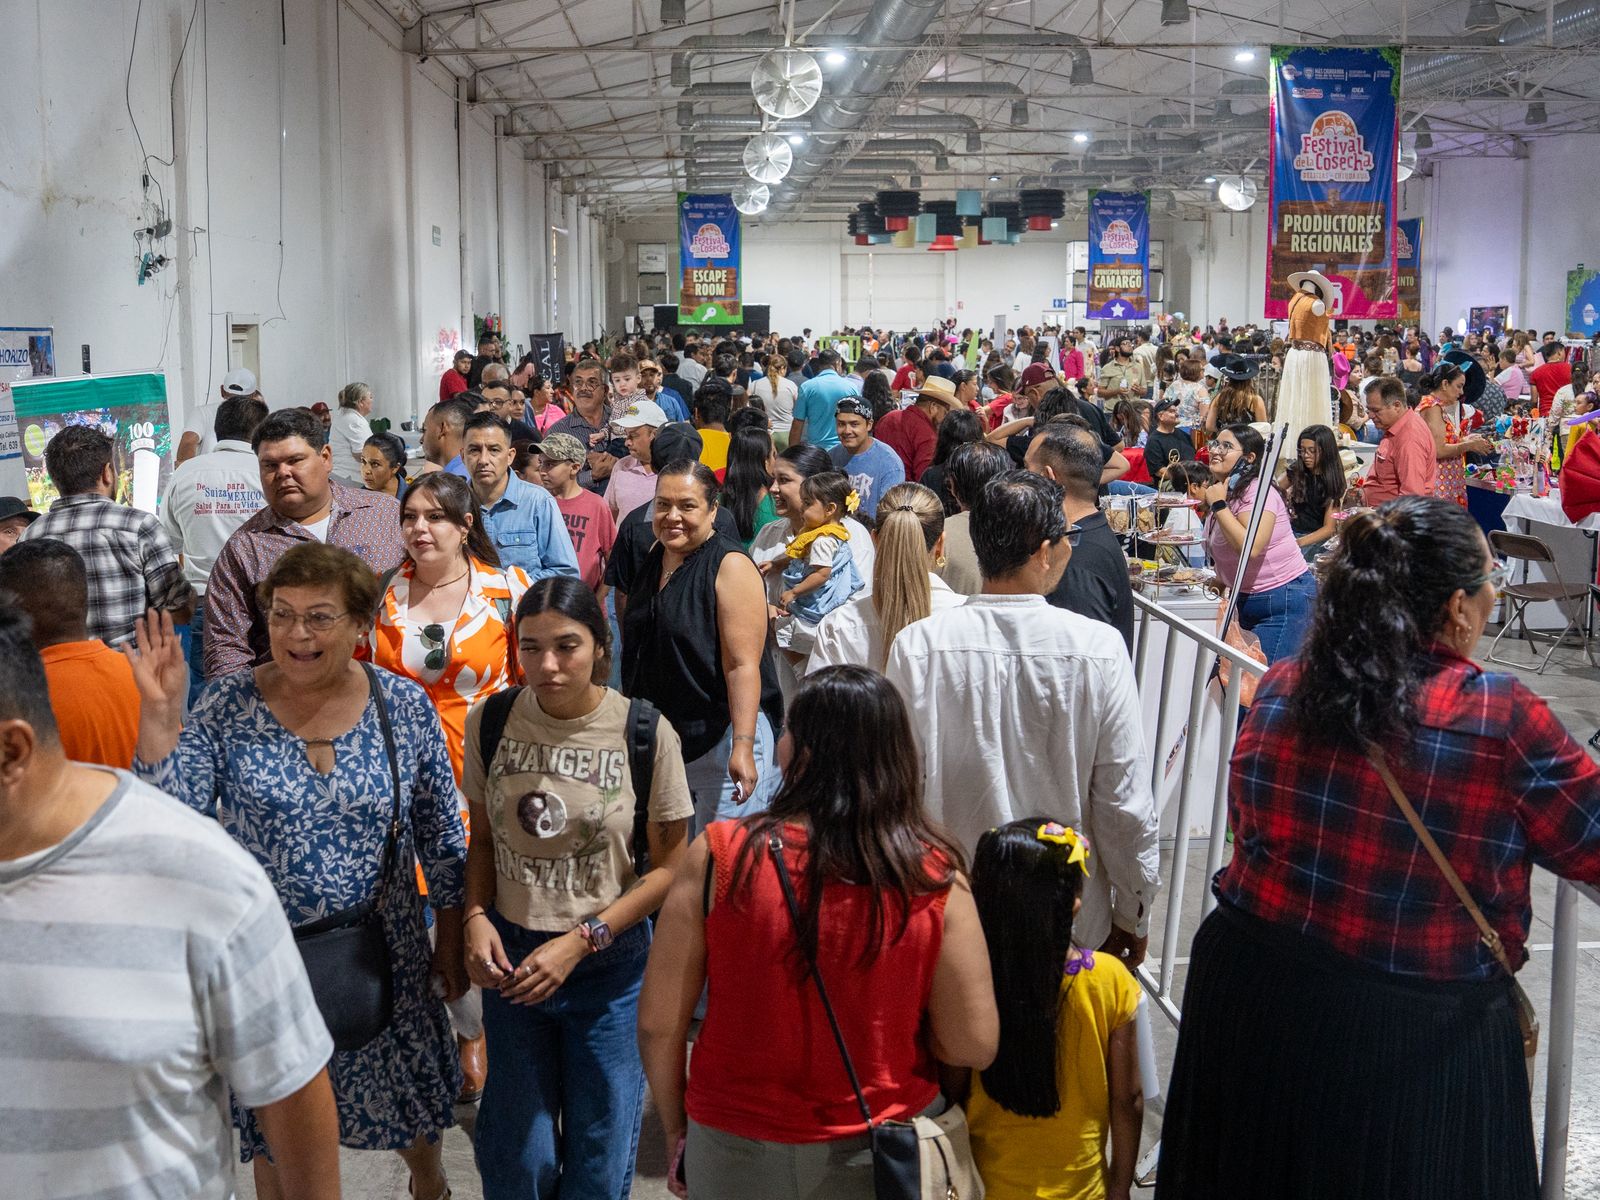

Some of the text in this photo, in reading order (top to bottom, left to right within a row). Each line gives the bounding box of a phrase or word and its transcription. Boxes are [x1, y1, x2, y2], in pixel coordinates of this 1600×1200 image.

[1303, 136, 1362, 155] Festival
[1295, 157, 1305, 167] de
[1315, 152, 1372, 171] Cosecha
[1283, 214, 1381, 234] PRODUCTORES
[694, 235, 724, 245] Festival
[1103, 232, 1133, 242] Festival
[1290, 234, 1374, 253] REGIONALES
[692, 269, 727, 282] ESCAPE
[1094, 275, 1142, 288] CAMARGO
[695, 283, 725, 296] ROOM
[128, 422, 155, 439] 100
[205, 488, 227, 497] Suiza
[226, 483, 245, 491] para
[562, 513, 590, 529] BUT
[494, 738, 625, 790] CHANGE IS
